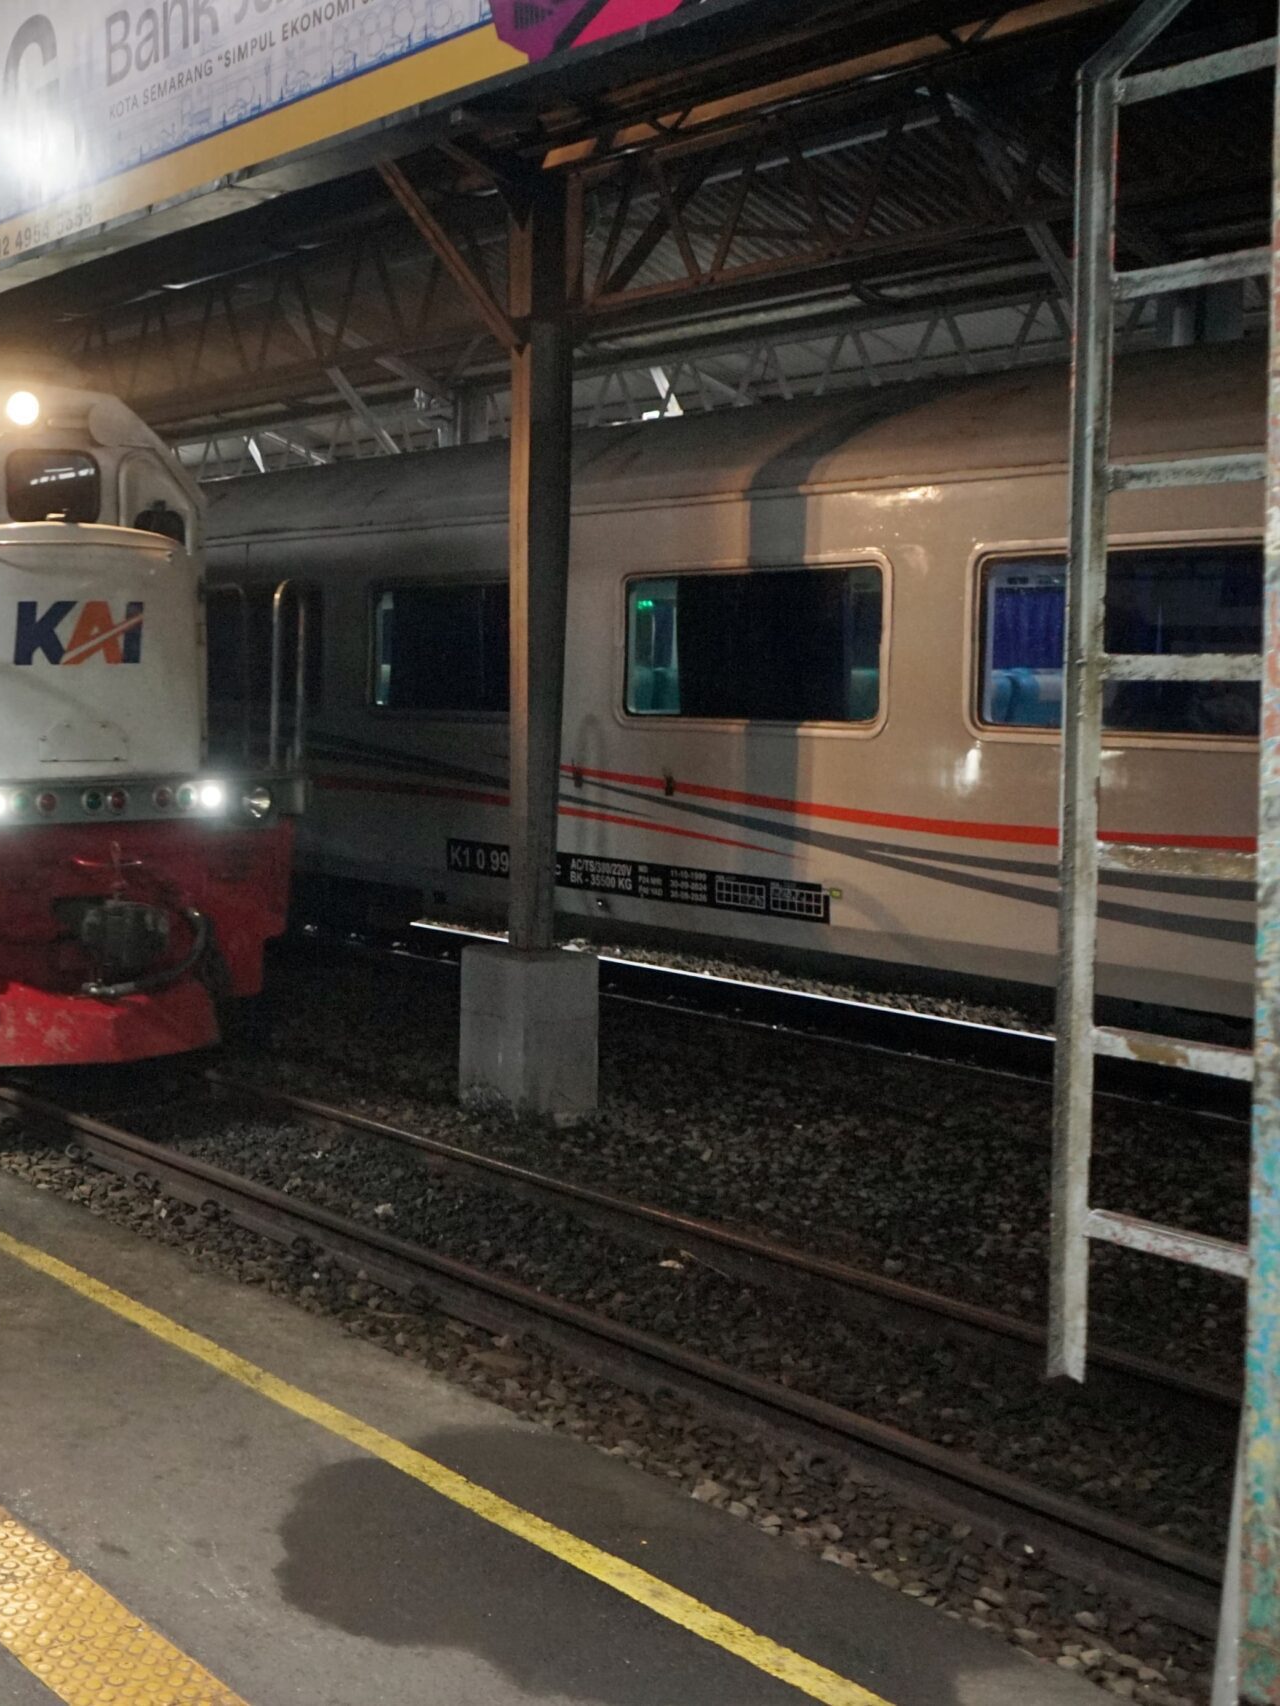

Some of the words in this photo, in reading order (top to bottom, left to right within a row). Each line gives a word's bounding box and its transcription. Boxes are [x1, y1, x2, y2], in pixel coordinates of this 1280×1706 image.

[104, 0, 219, 87] Bank
[109, 94, 140, 120] KOTA
[142, 58, 214, 105] SEMARANG
[13, 600, 144, 665] KAI
[451, 845, 470, 867] K1
[490, 850, 509, 872] 99
[570, 871, 584, 884] BK
[618, 878, 633, 891] KG
